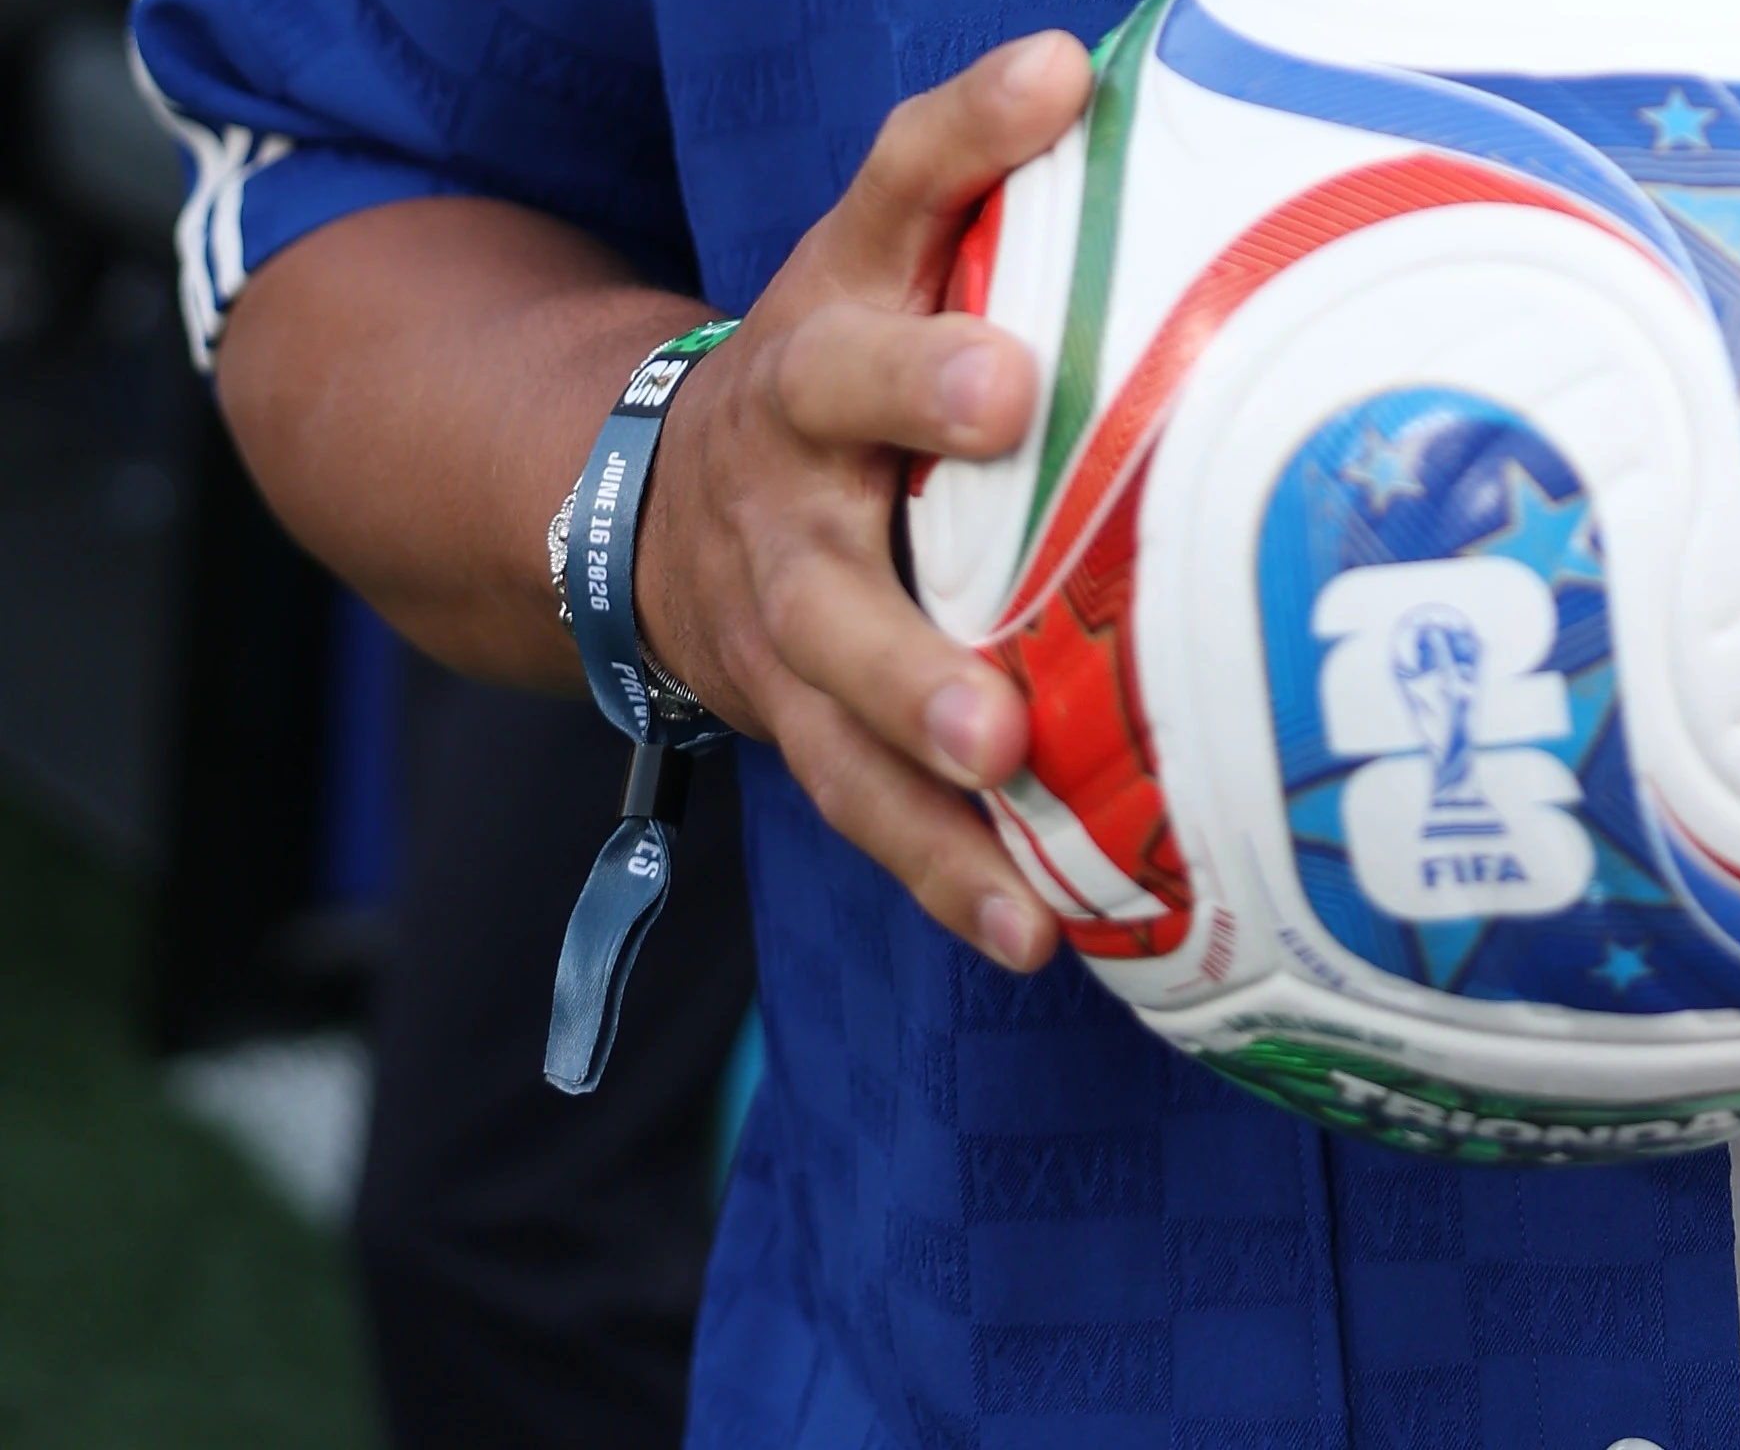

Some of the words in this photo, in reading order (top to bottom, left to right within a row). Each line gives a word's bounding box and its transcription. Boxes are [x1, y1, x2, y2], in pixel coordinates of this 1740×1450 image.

[595, 451, 627, 512] JUNE
[589, 515, 612, 545] 16
[587, 549, 611, 612] 2026
[1420, 855, 1528, 889] FIFA
